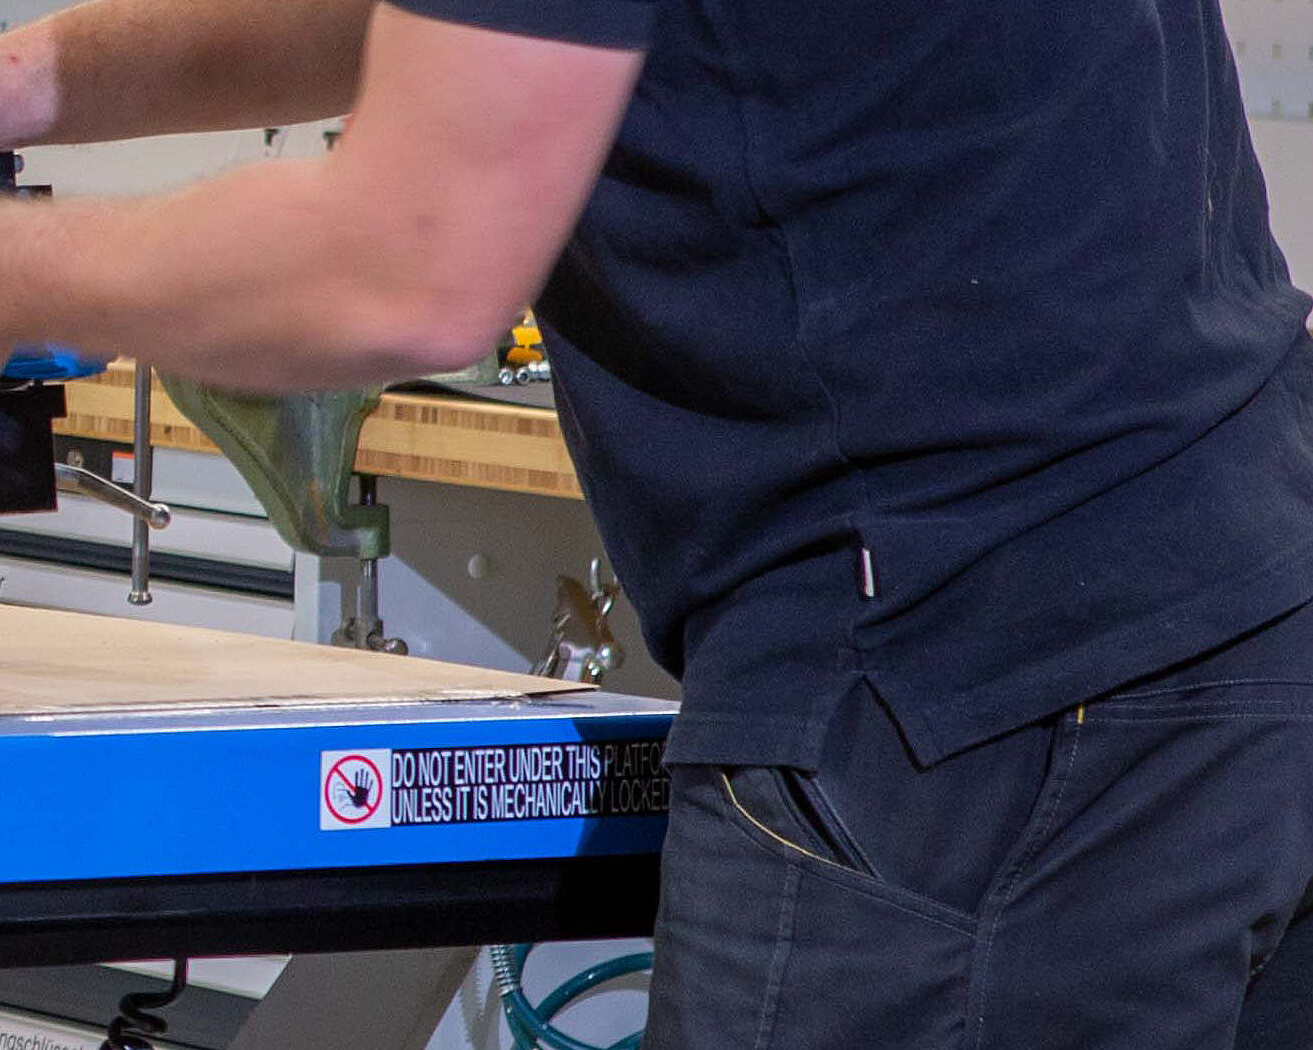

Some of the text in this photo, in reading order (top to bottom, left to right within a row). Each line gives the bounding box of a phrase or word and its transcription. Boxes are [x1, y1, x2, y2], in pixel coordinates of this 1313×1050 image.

[392, 752, 416, 788] DO
[418, 750, 452, 786] NOT
[454, 748, 506, 785] ENTER
[508, 746, 564, 783] UNDER
[565, 743, 601, 780] THIS
[392, 787, 453, 824] UNLESS
[455, 785, 471, 821] IT
[473, 784, 488, 820] IS
[491, 778, 607, 820] MECHANICALLY
